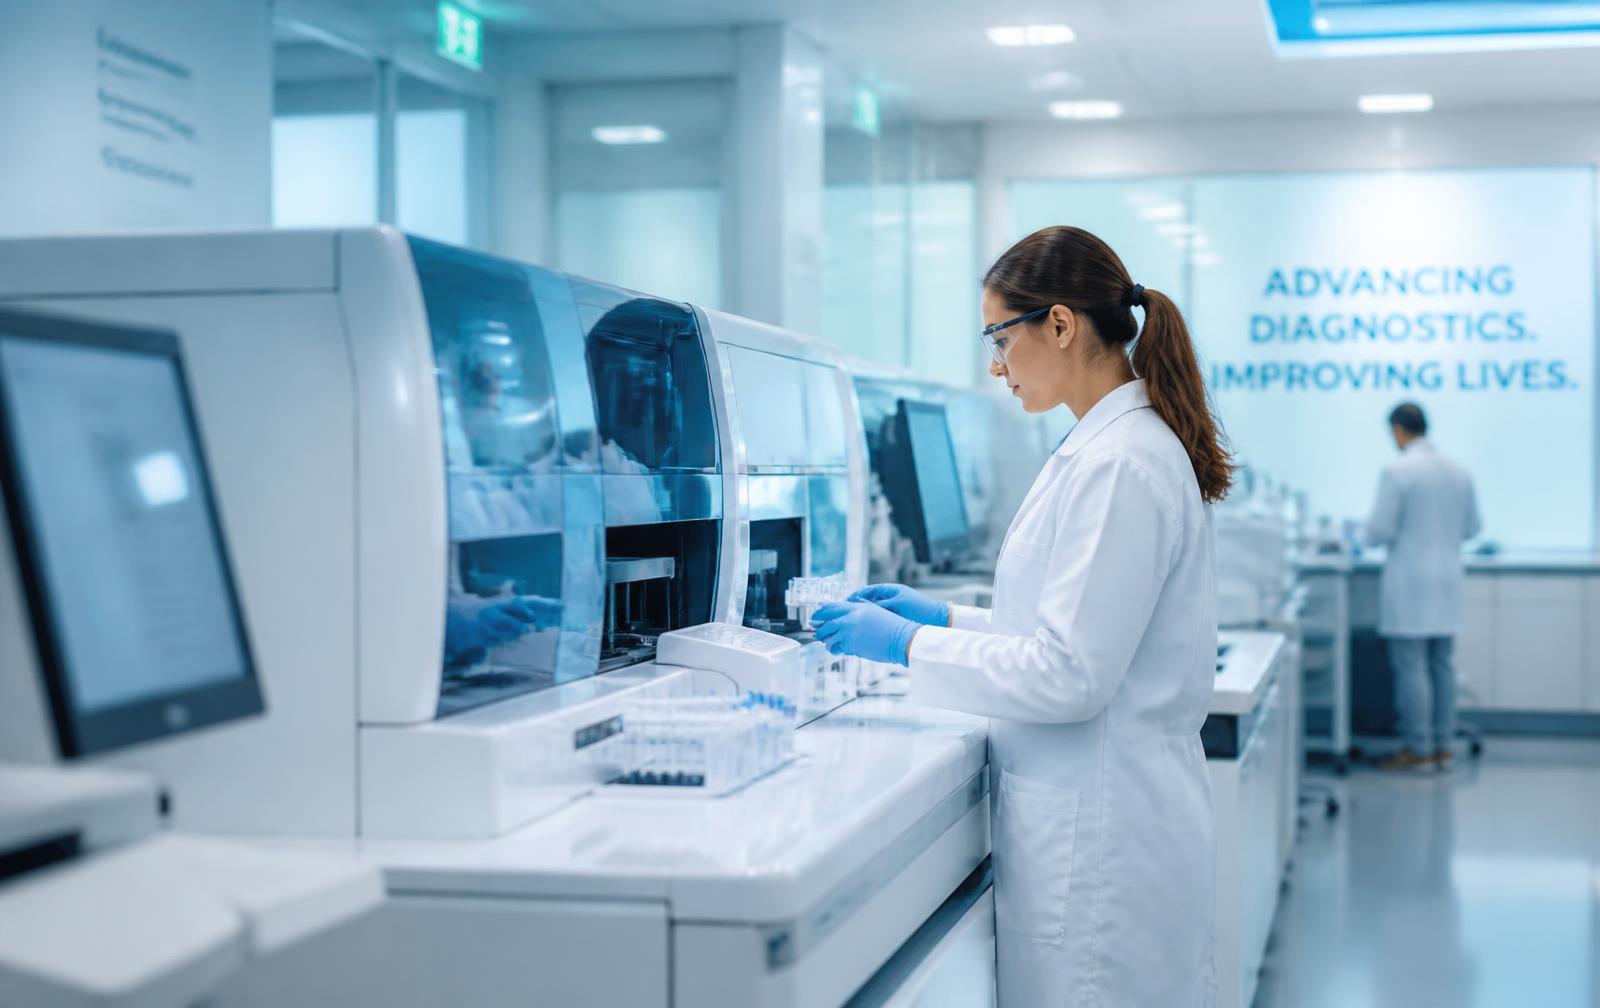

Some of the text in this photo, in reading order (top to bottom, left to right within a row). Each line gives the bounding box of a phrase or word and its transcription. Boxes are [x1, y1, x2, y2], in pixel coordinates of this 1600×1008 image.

[1264, 266, 1514, 297] ADVANCING
[1250, 313, 1537, 343] DIAGNOSTICS.
[1211, 360, 1578, 391] IMPROVING LIVES.
